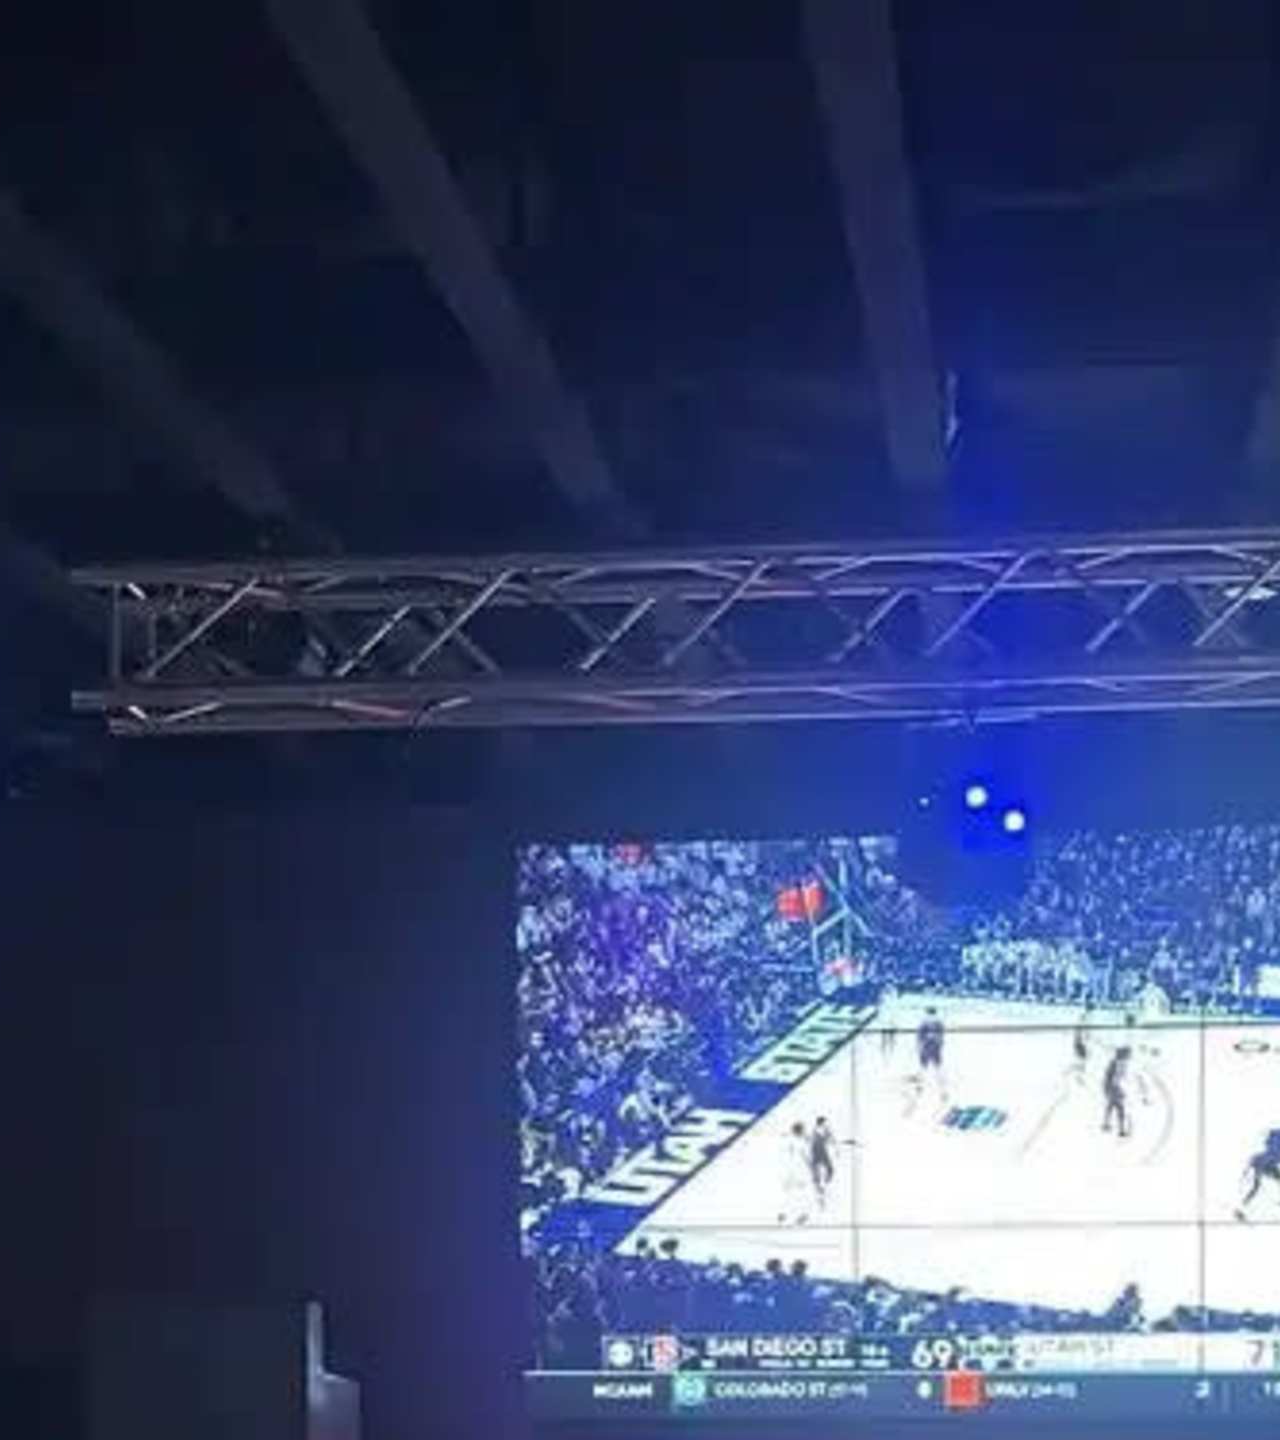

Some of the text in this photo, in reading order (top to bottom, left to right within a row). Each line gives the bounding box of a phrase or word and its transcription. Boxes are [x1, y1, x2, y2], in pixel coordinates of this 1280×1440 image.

[706, 1338, 748, 1356] SAN
[753, 1338, 816, 1356] DIEGO
[821, 1338, 846, 1356] ST
[912, 1338, 952, 1369] 69
[714, 1381, 806, 1398] COLORADO
